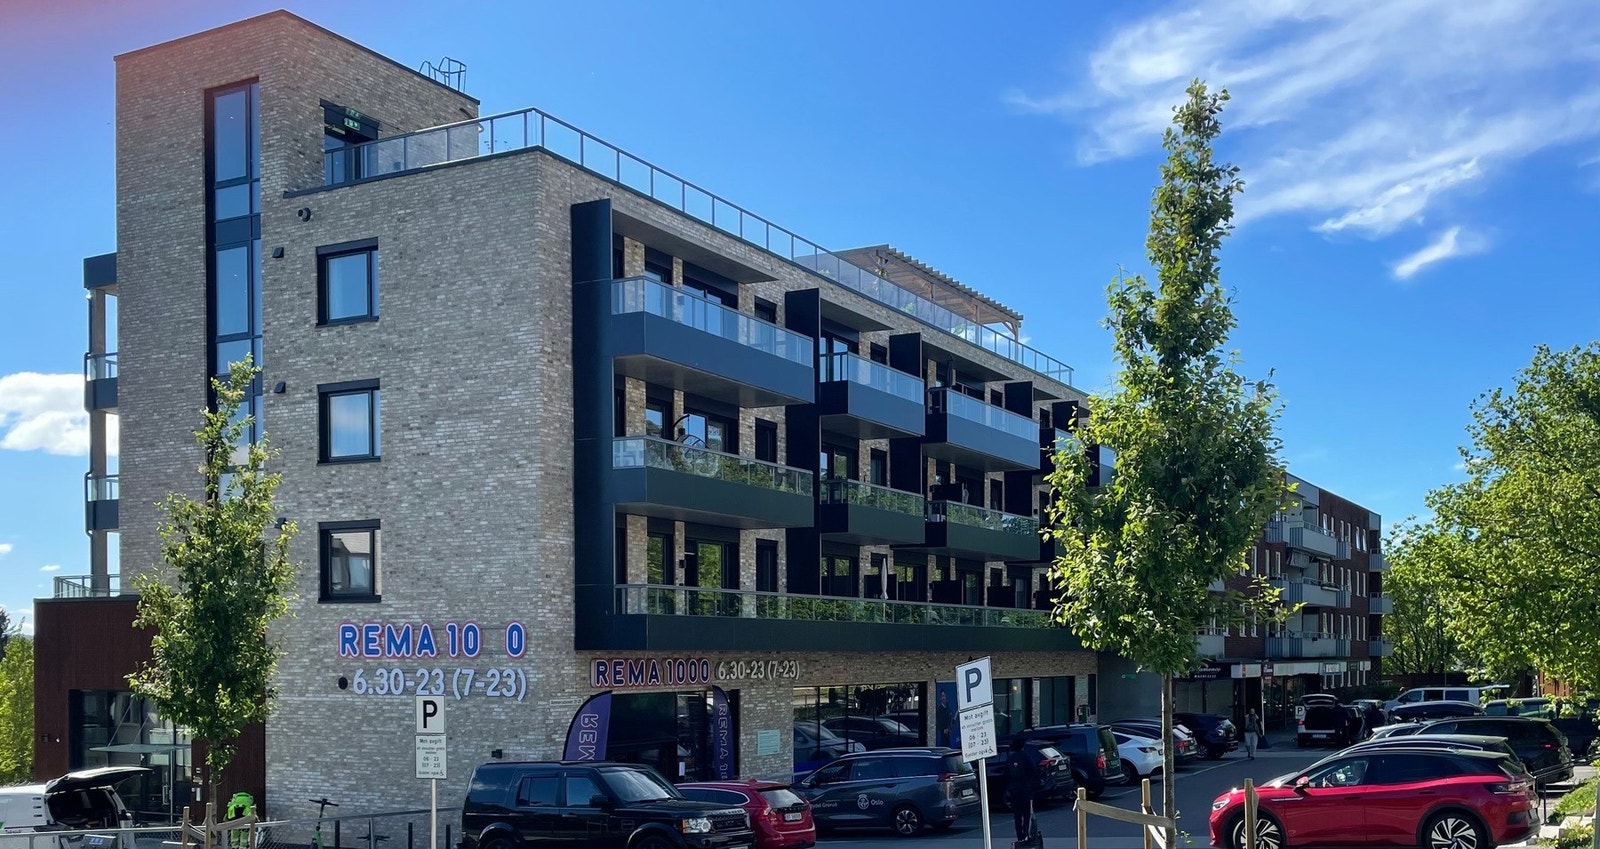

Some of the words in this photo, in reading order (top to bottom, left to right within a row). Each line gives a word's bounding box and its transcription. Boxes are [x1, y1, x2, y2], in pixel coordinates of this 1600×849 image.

[339, 623, 436, 657] REMA
[446, 622, 480, 657] 10
[352, 668, 445, 696] 6.30-23
[452, 668, 526, 701] (7-23)
[594, 659, 661, 686] REMA
[665, 659, 710, 684] 1000
[718, 660, 765, 680] 6.30-23
[768, 660, 800, 680] (7-23)
[965, 667, 982, 703] P
[423, 700, 438, 728] P
[1297, 706, 1303, 715] P
[718, 703, 729, 759] REMA
[871, 798, 884, 806] Oslo
